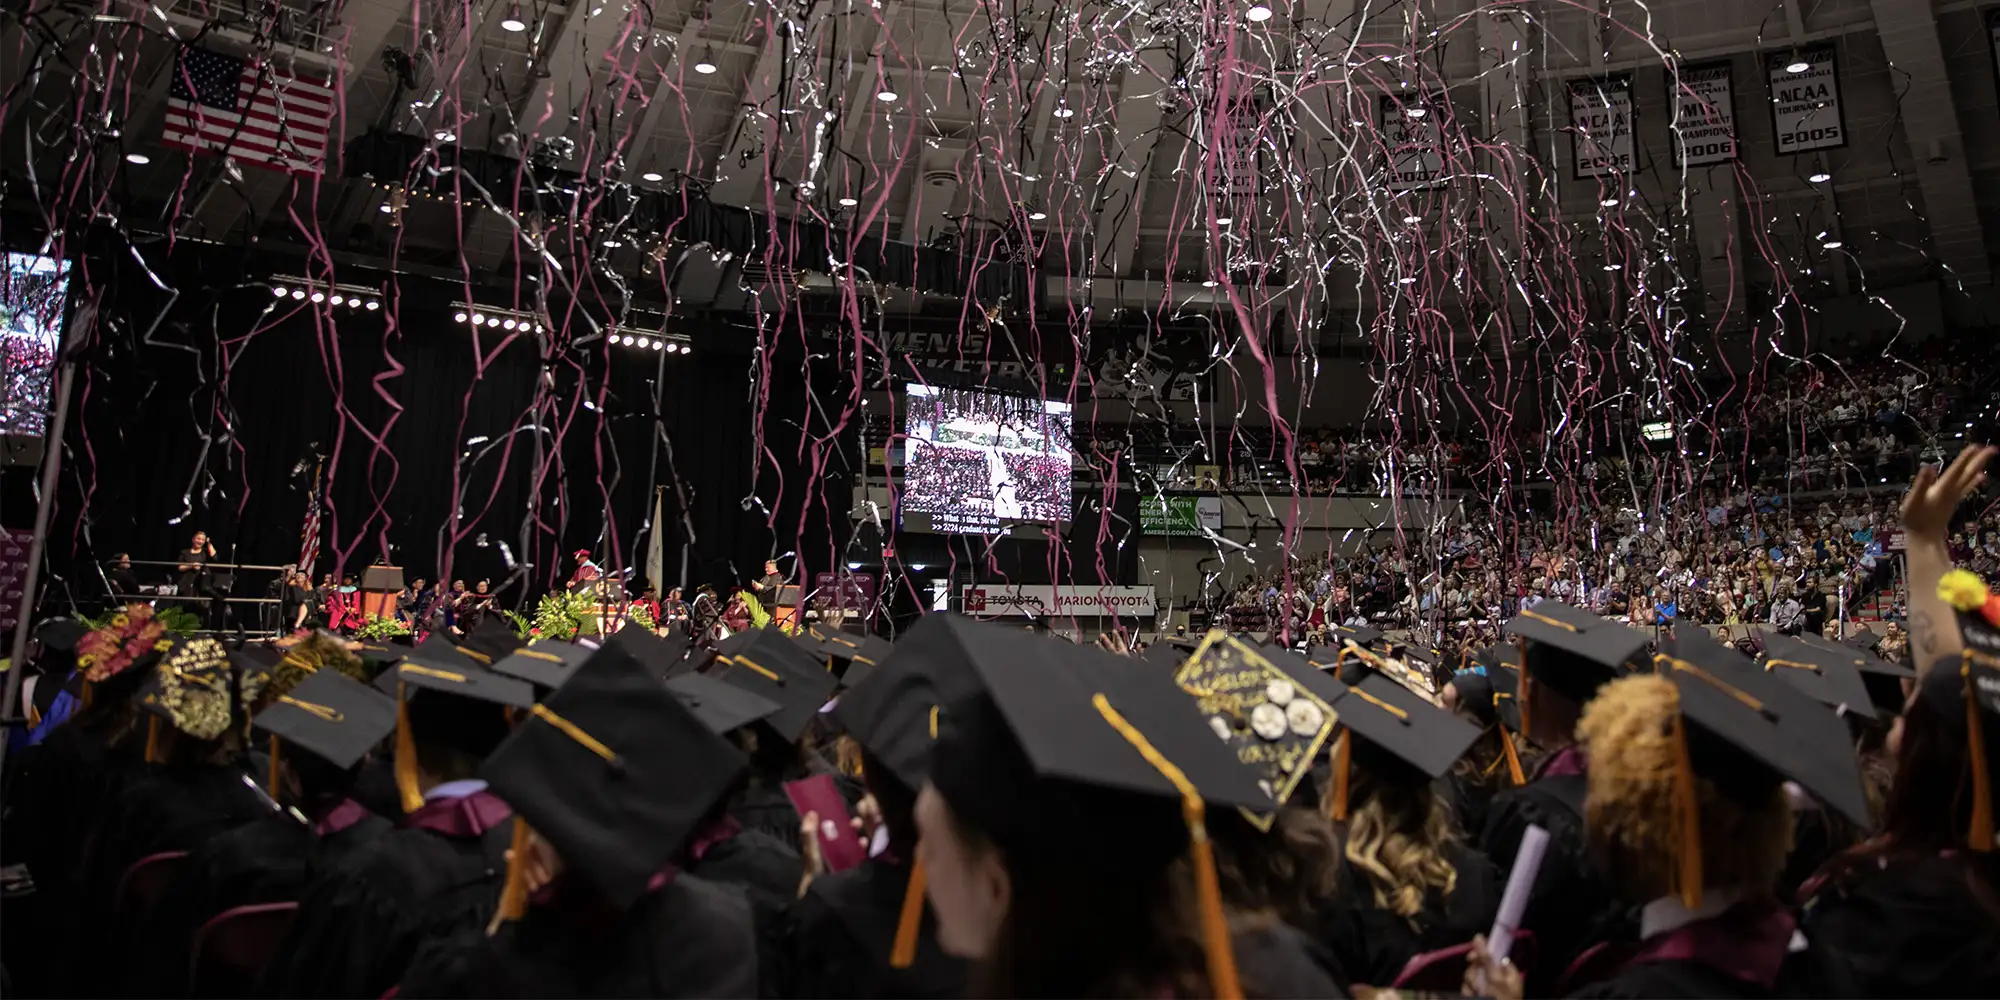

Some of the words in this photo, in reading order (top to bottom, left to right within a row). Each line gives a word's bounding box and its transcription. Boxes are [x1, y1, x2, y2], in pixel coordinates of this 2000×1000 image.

[1780, 83, 1829, 103] NCAA
[1779, 99, 1834, 115] TOURNAMNT
[1781, 126, 1838, 145] 2005
[1139, 508, 1173, 517] ENERY
[991, 595, 1040, 606] TOYOTA
[1057, 595, 1101, 606] MARION
[1104, 595, 1150, 606] TOYOTA
